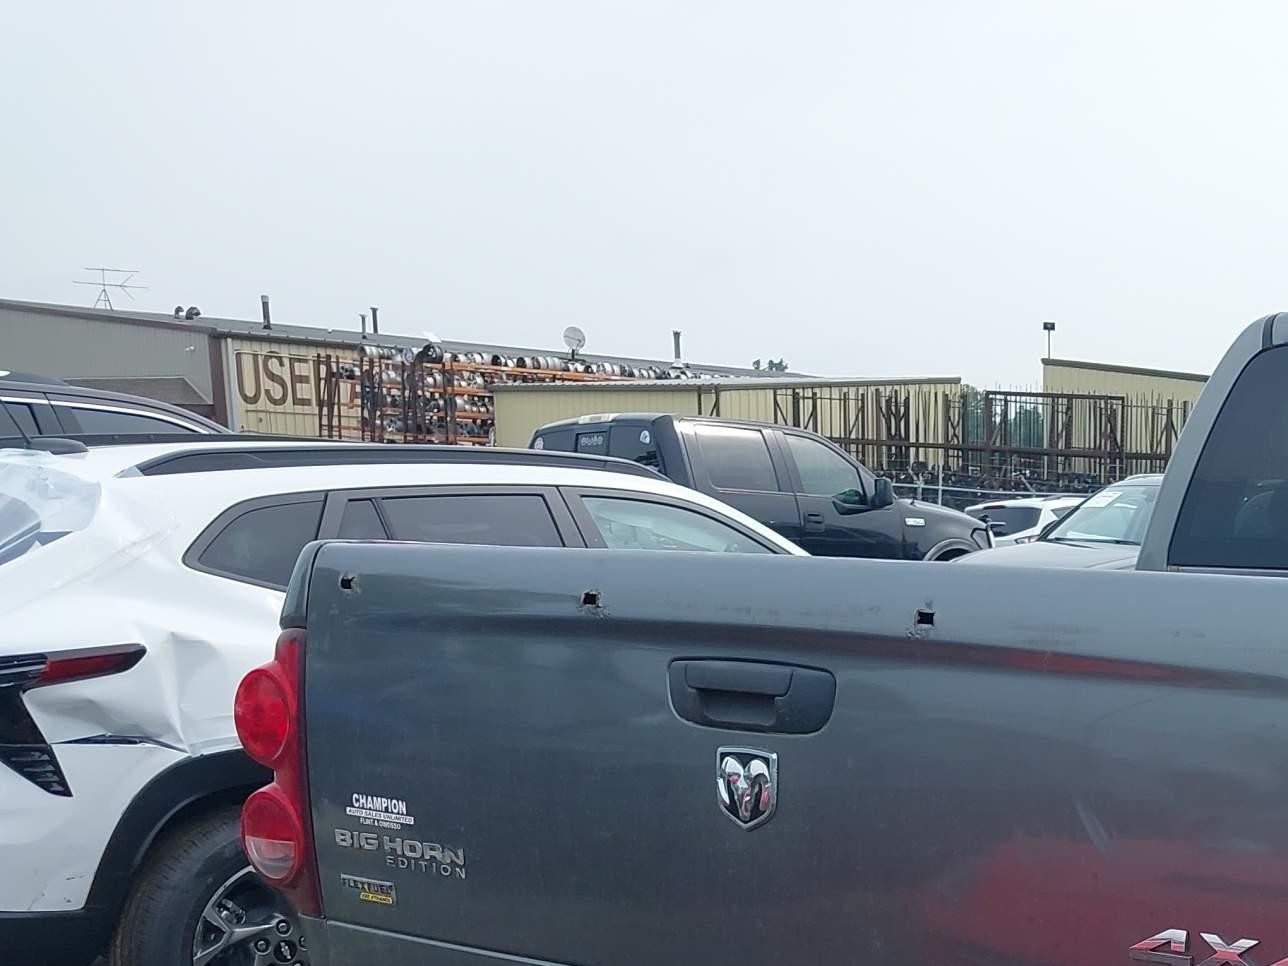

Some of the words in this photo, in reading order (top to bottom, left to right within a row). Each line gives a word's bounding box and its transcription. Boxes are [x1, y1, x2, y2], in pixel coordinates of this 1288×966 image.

[352, 793, 407, 815] CHAMPION
[364, 810, 382, 819] SALES
[383, 813, 413, 824] UNLIMITED
[334, 828, 379, 850] BIG
[383, 836, 465, 866] HORN
[386, 855, 466, 880] EDITION
